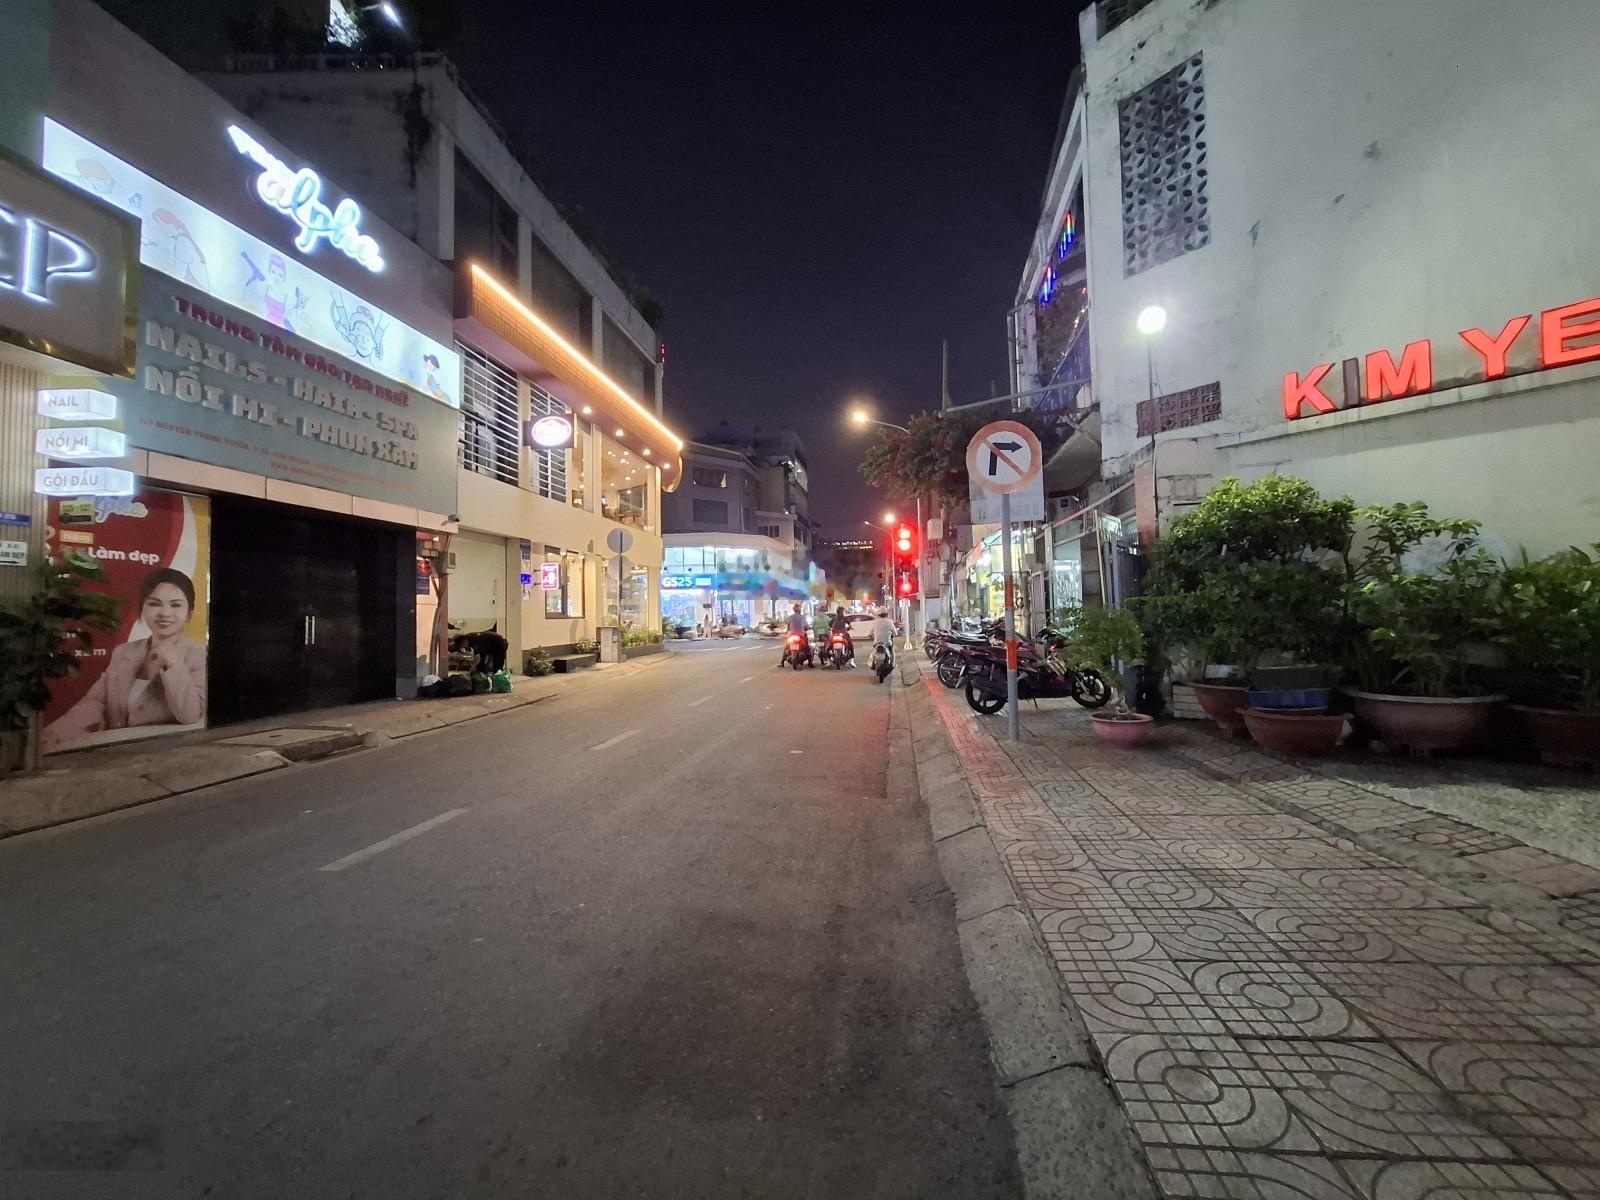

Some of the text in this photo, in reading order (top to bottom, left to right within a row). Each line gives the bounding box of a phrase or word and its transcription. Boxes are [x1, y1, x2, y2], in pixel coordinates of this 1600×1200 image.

[172, 296, 255, 342] TRUNG
[48, 395, 79, 408] NAIL
[146, 320, 268, 385] NAILS
[294, 377, 361, 420] HAIR
[378, 412, 418, 441] SPA
[1282, 339, 1432, 420] KIM
[73, 435, 89, 450] MI
[232, 394, 277, 426] MI
[303, 416, 367, 456] PHUN
[662, 576, 692, 588] GS25
